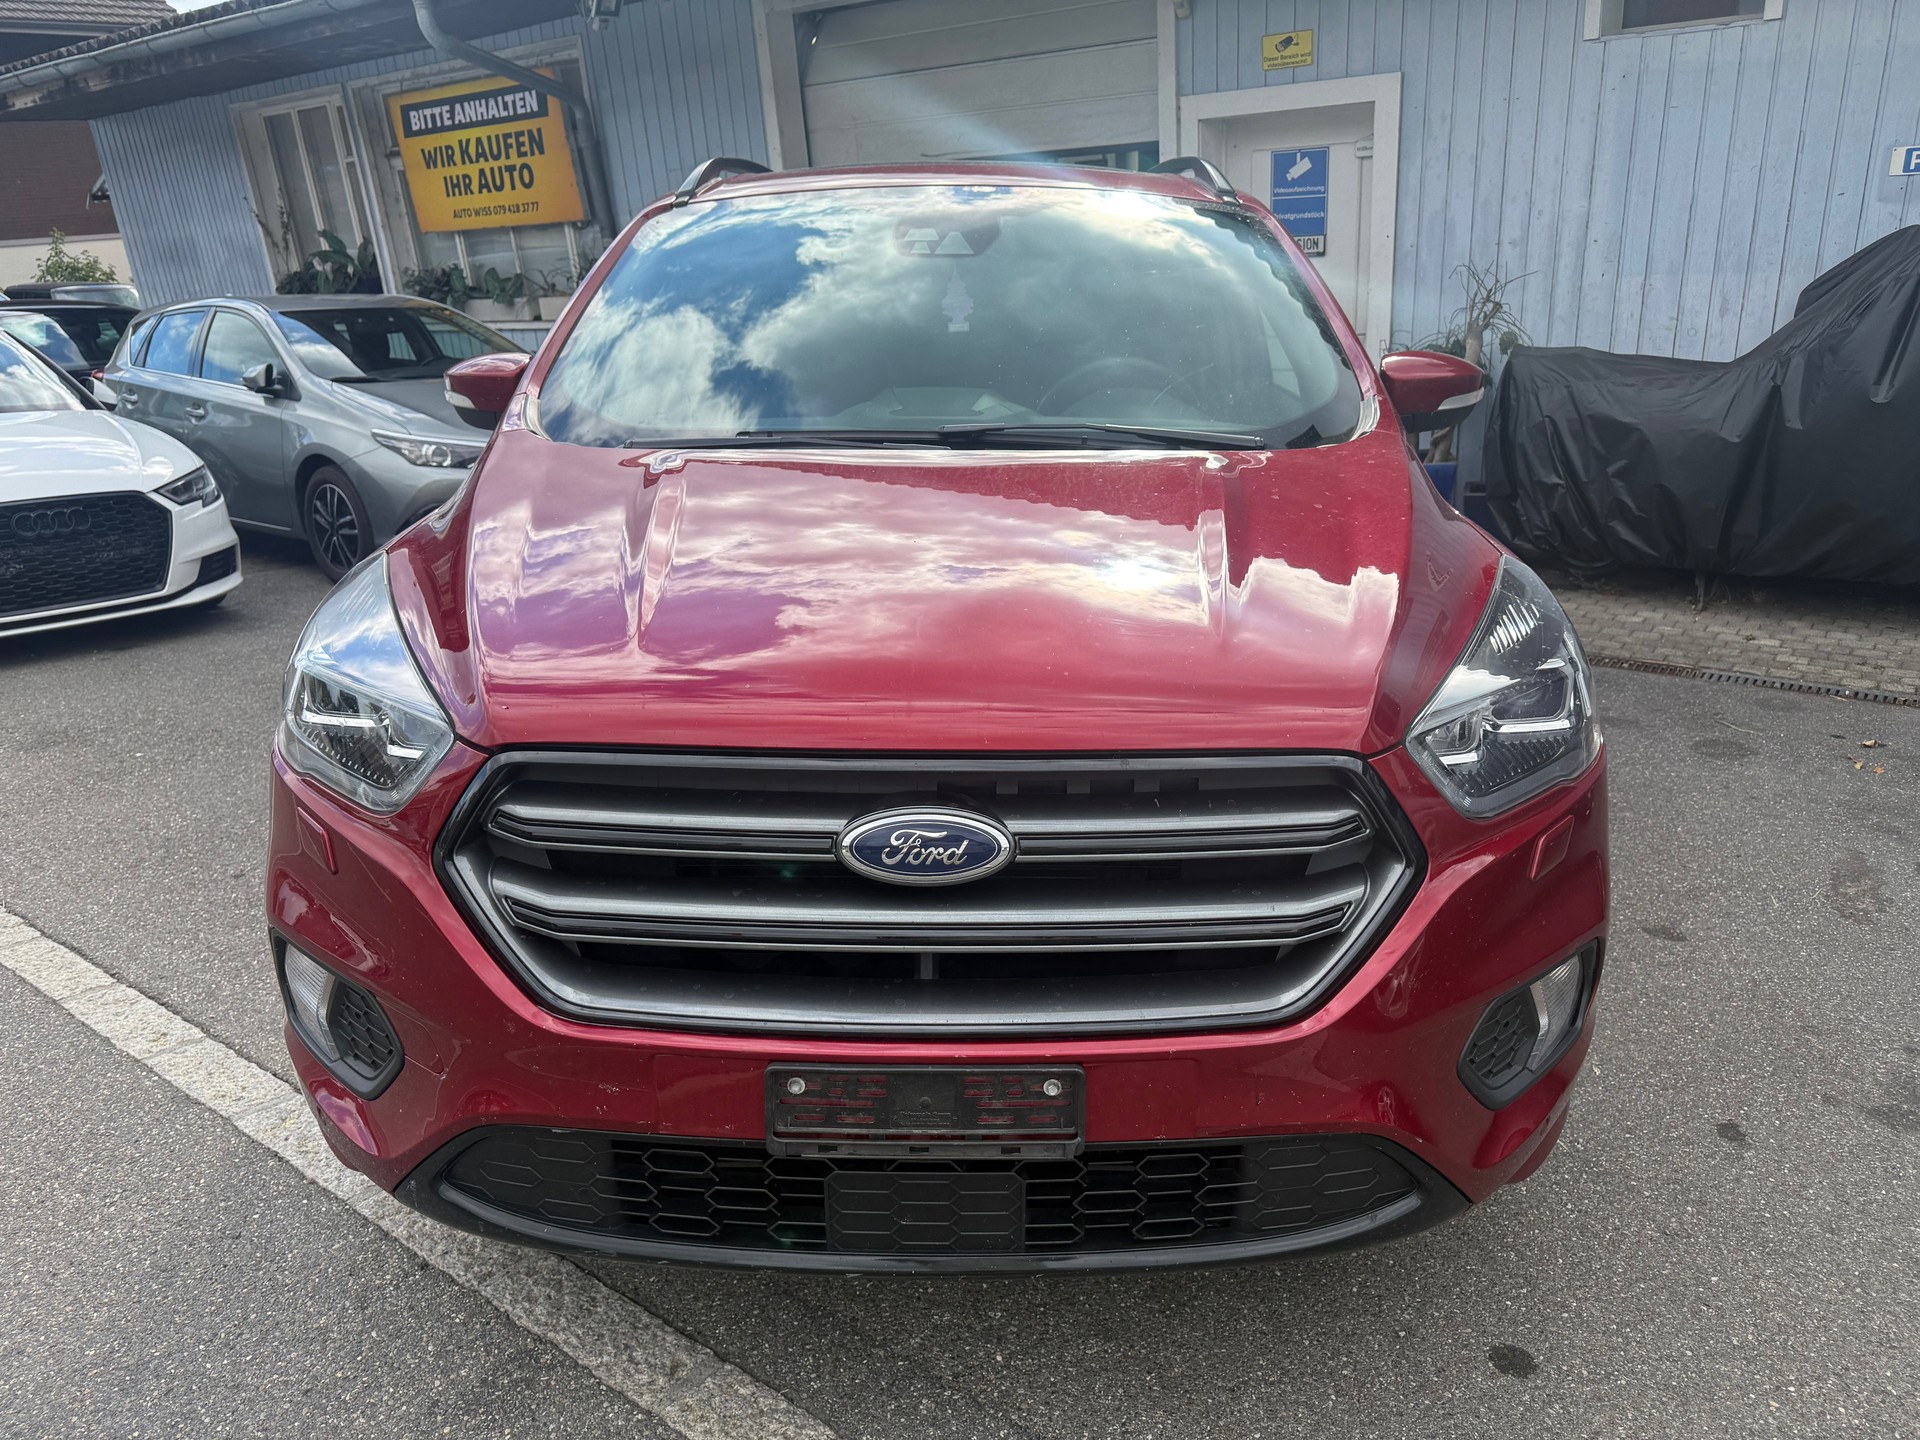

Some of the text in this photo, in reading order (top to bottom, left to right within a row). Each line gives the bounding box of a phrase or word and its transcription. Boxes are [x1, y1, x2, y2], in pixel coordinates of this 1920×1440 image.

[409, 89, 539, 131] BITTE ANHALTEN
[421, 127, 545, 170] WIR KAUFEN
[443, 162, 535, 198] IHR AUTO
[453, 201, 539, 219] AUTO WISS 079 418 37 77
[881, 829, 968, 865] Ford
